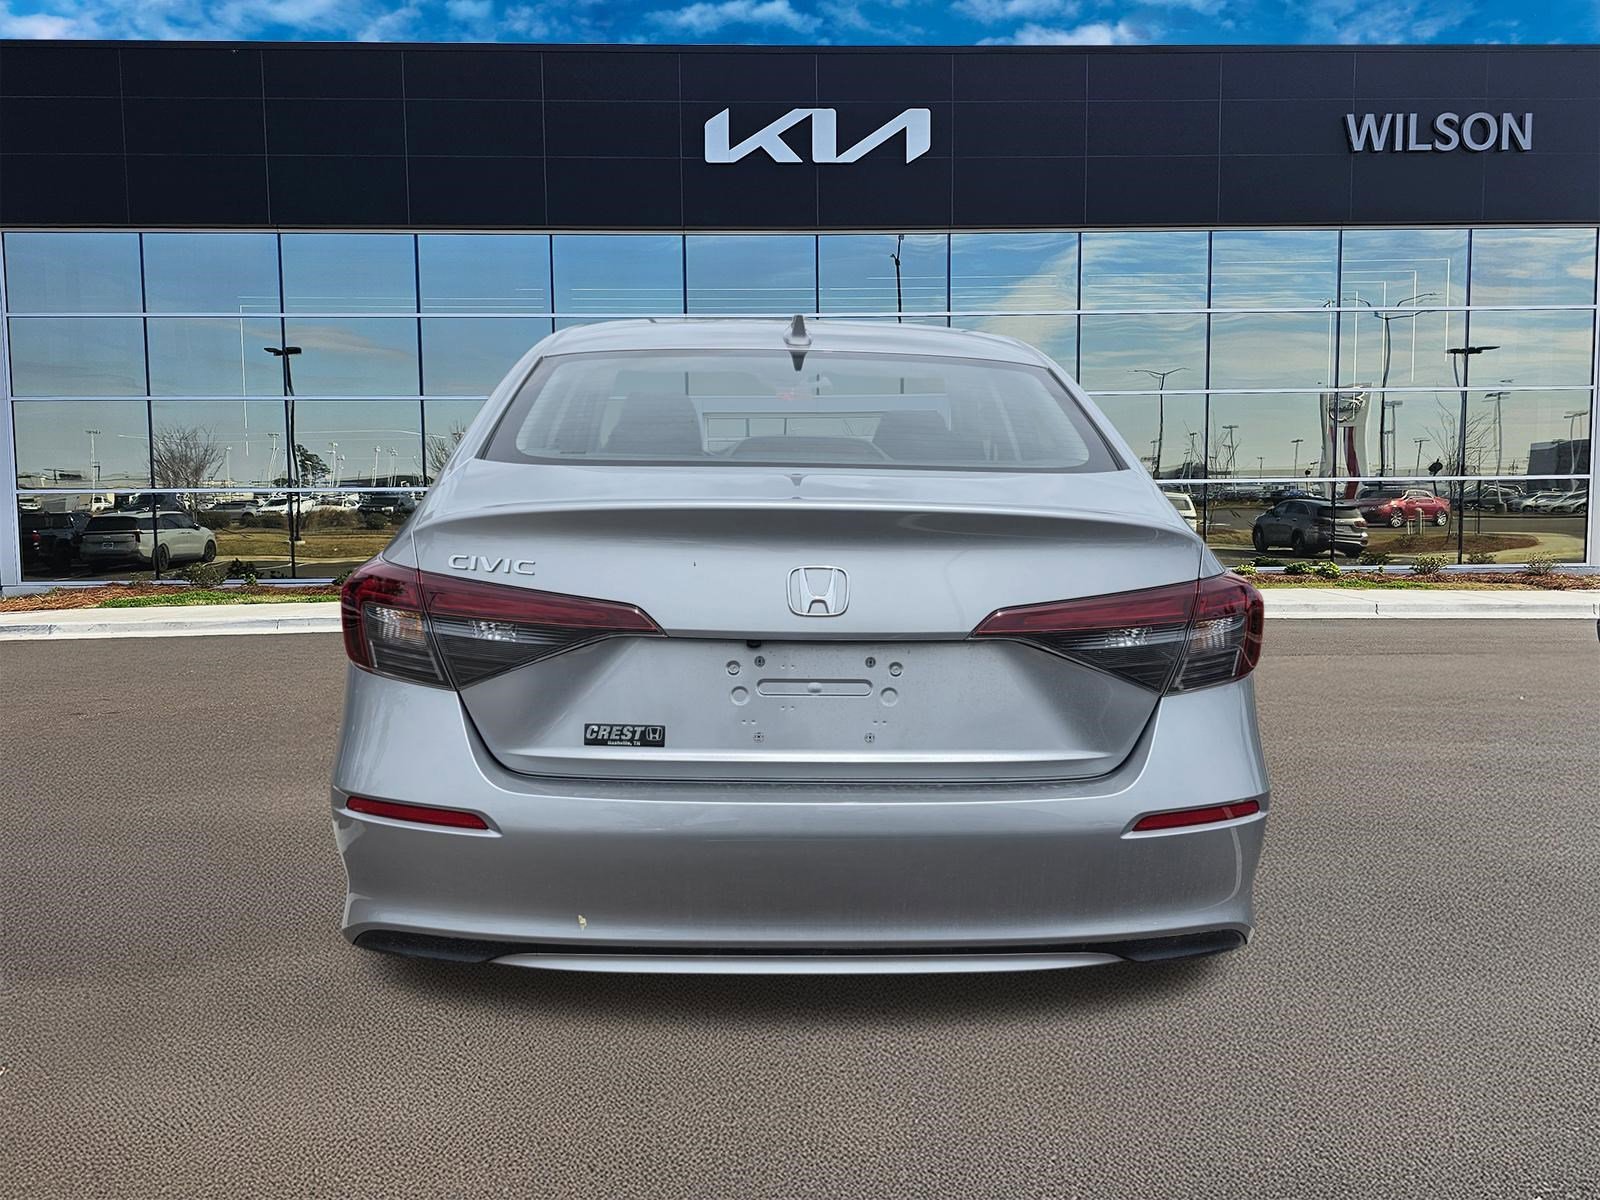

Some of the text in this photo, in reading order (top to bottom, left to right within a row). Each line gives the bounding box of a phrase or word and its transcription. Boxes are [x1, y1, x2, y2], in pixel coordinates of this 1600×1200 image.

[1344, 111, 1534, 153] WILSON
[448, 554, 536, 576] CIVIC
[585, 725, 645, 740] CREST
